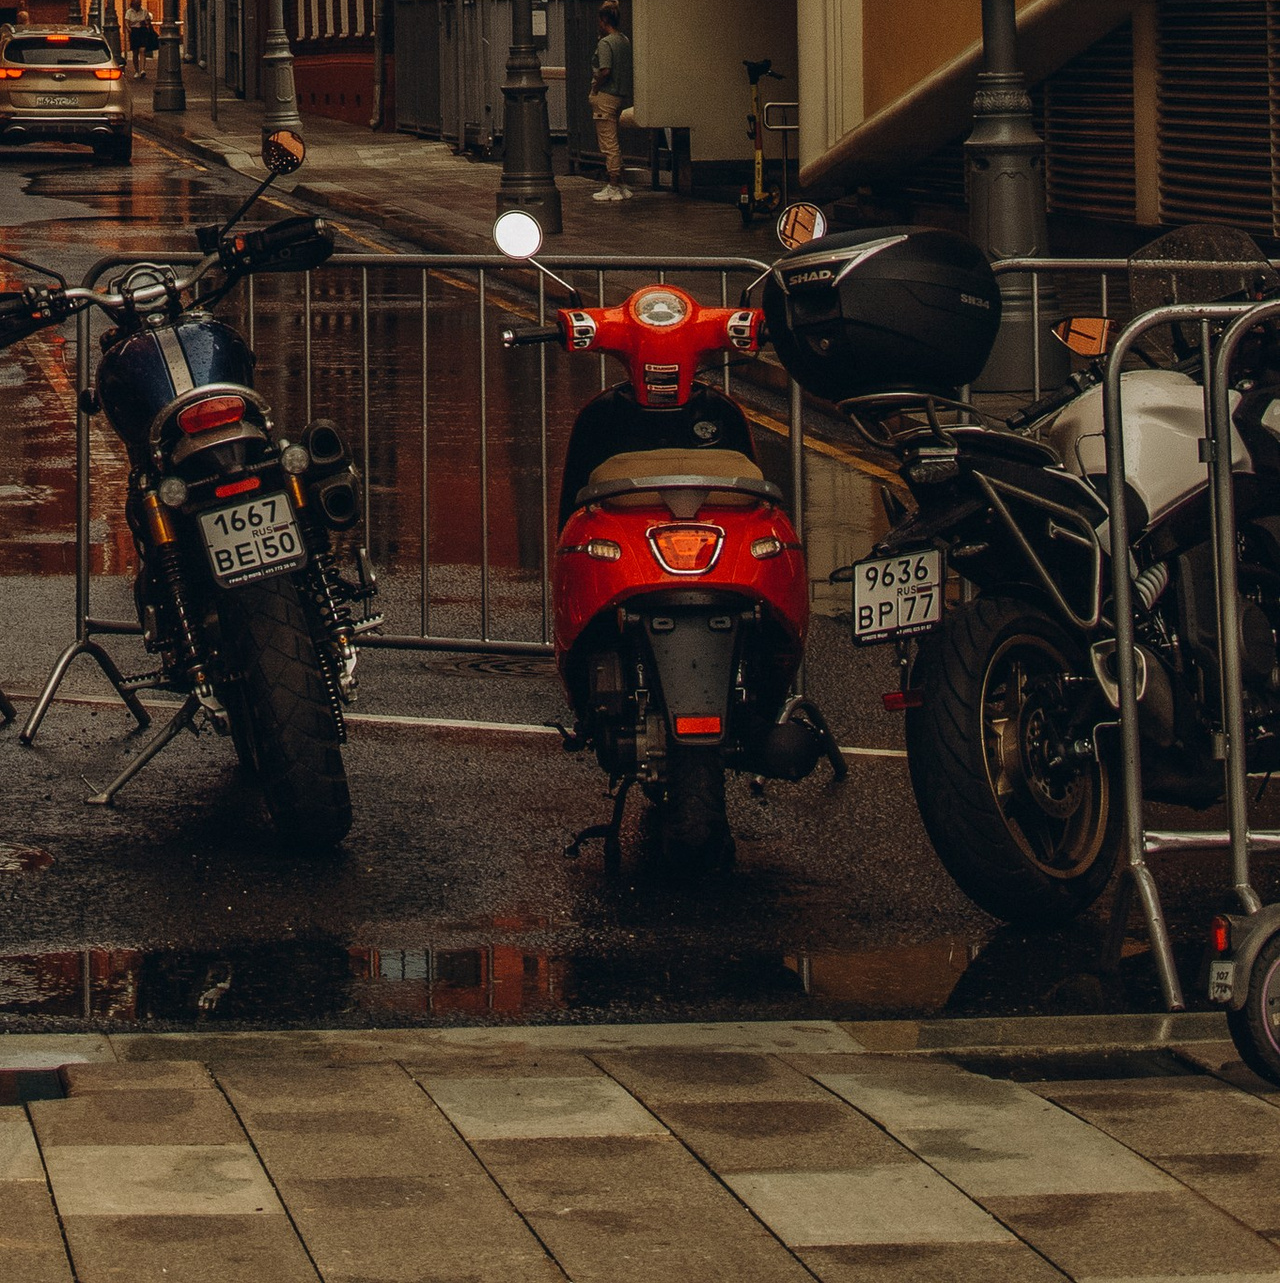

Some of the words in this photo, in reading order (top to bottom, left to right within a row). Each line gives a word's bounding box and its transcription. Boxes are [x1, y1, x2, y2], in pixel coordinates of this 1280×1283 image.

[789, 269, 832, 286] SHAD
[960, 293, 991, 310] SH34
[214, 500, 276, 535] 1667
[251, 526, 274, 538] RUS
[215, 542, 256, 572] ВЕ
[261, 532, 295, 558] 50
[865, 556, 928, 591] 9636
[897, 585, 917, 596] RUS
[859, 601, 894, 630] ВР
[903, 593, 933, 621] 77
[1215, 971, 1229, 981] 107
